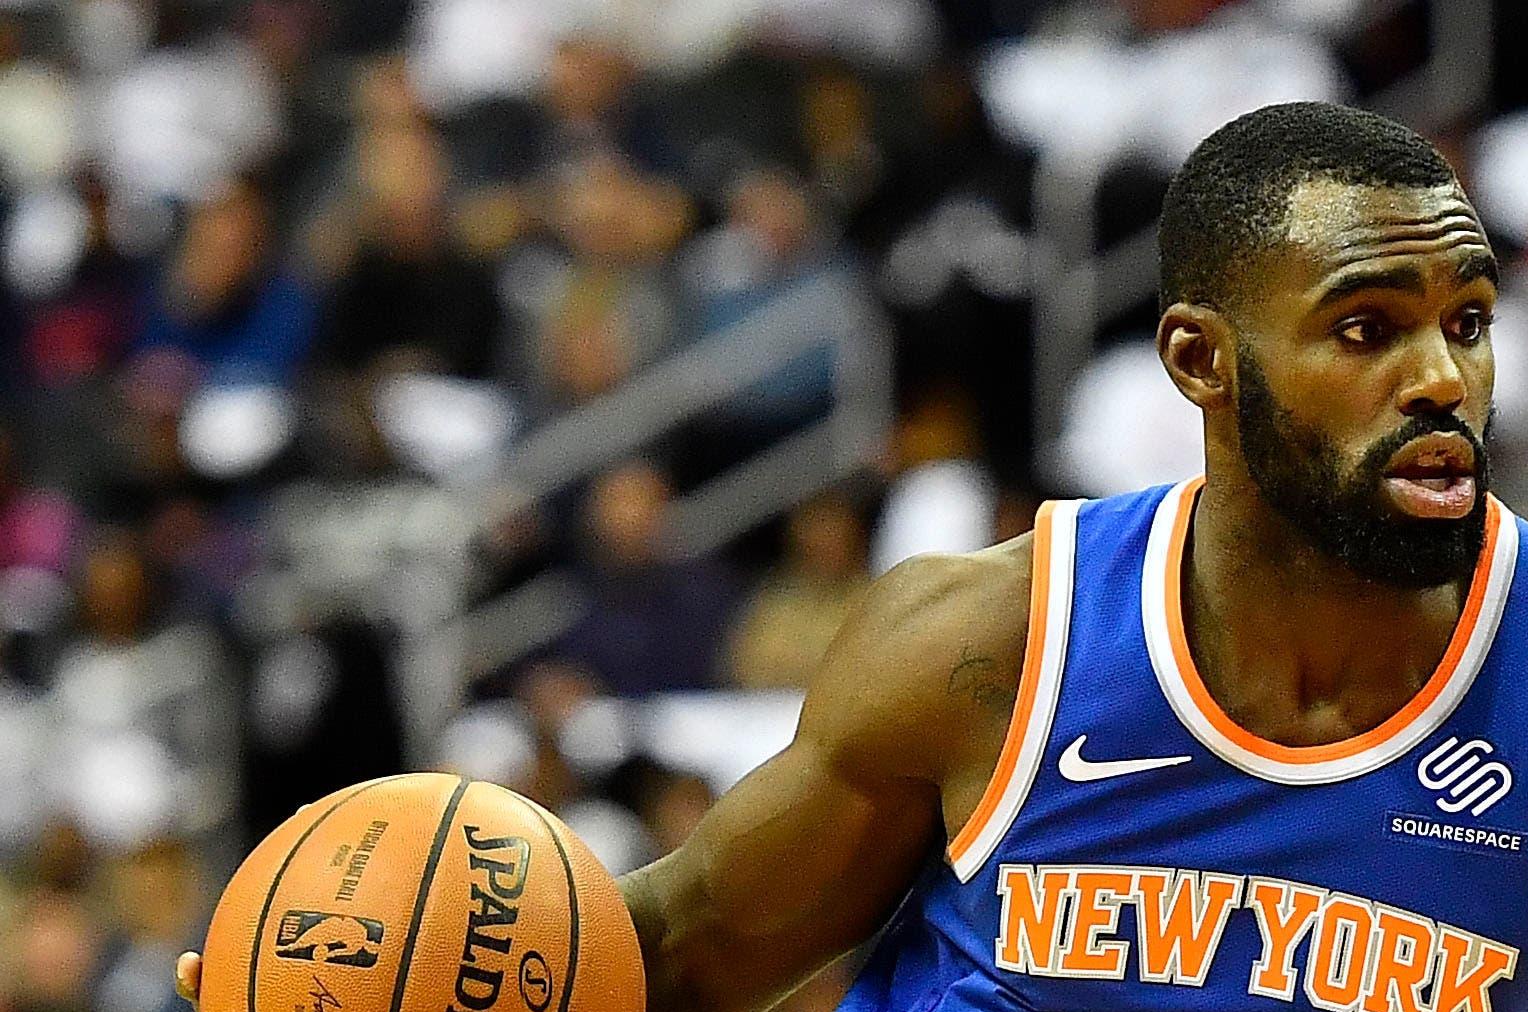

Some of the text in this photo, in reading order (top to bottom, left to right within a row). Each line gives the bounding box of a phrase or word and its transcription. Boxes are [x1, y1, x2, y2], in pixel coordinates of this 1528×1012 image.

[1391, 817, 1522, 851] SQUARESPACE
[335, 878, 359, 902] BALL
[281, 915, 301, 940] NBA
[995, 864, 1247, 986] NEW
